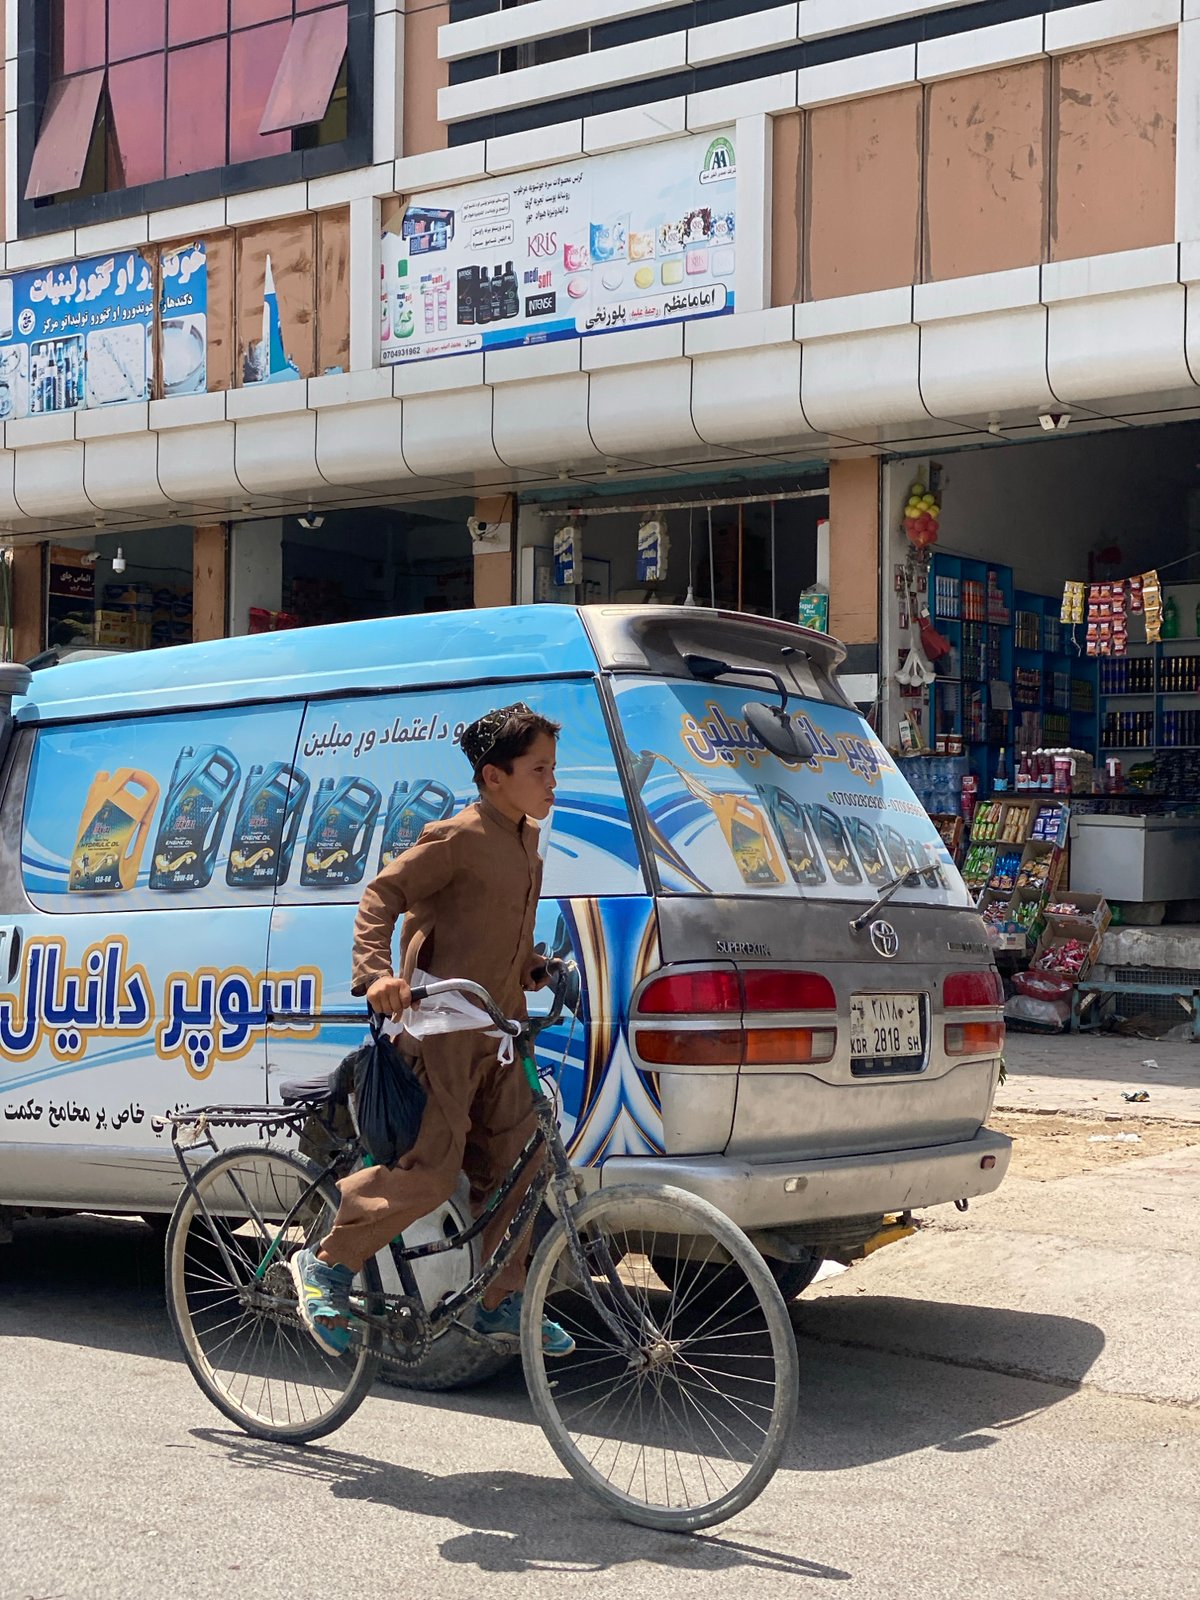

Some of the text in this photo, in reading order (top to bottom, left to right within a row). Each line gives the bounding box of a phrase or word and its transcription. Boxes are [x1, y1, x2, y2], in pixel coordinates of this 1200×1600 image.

[115, 255, 134, 295] او
[161, 974, 316, 1072] سوپر
[850, 1027, 920, 1054] KDR 2818 SH
[111, 1102, 145, 1130] خاص
